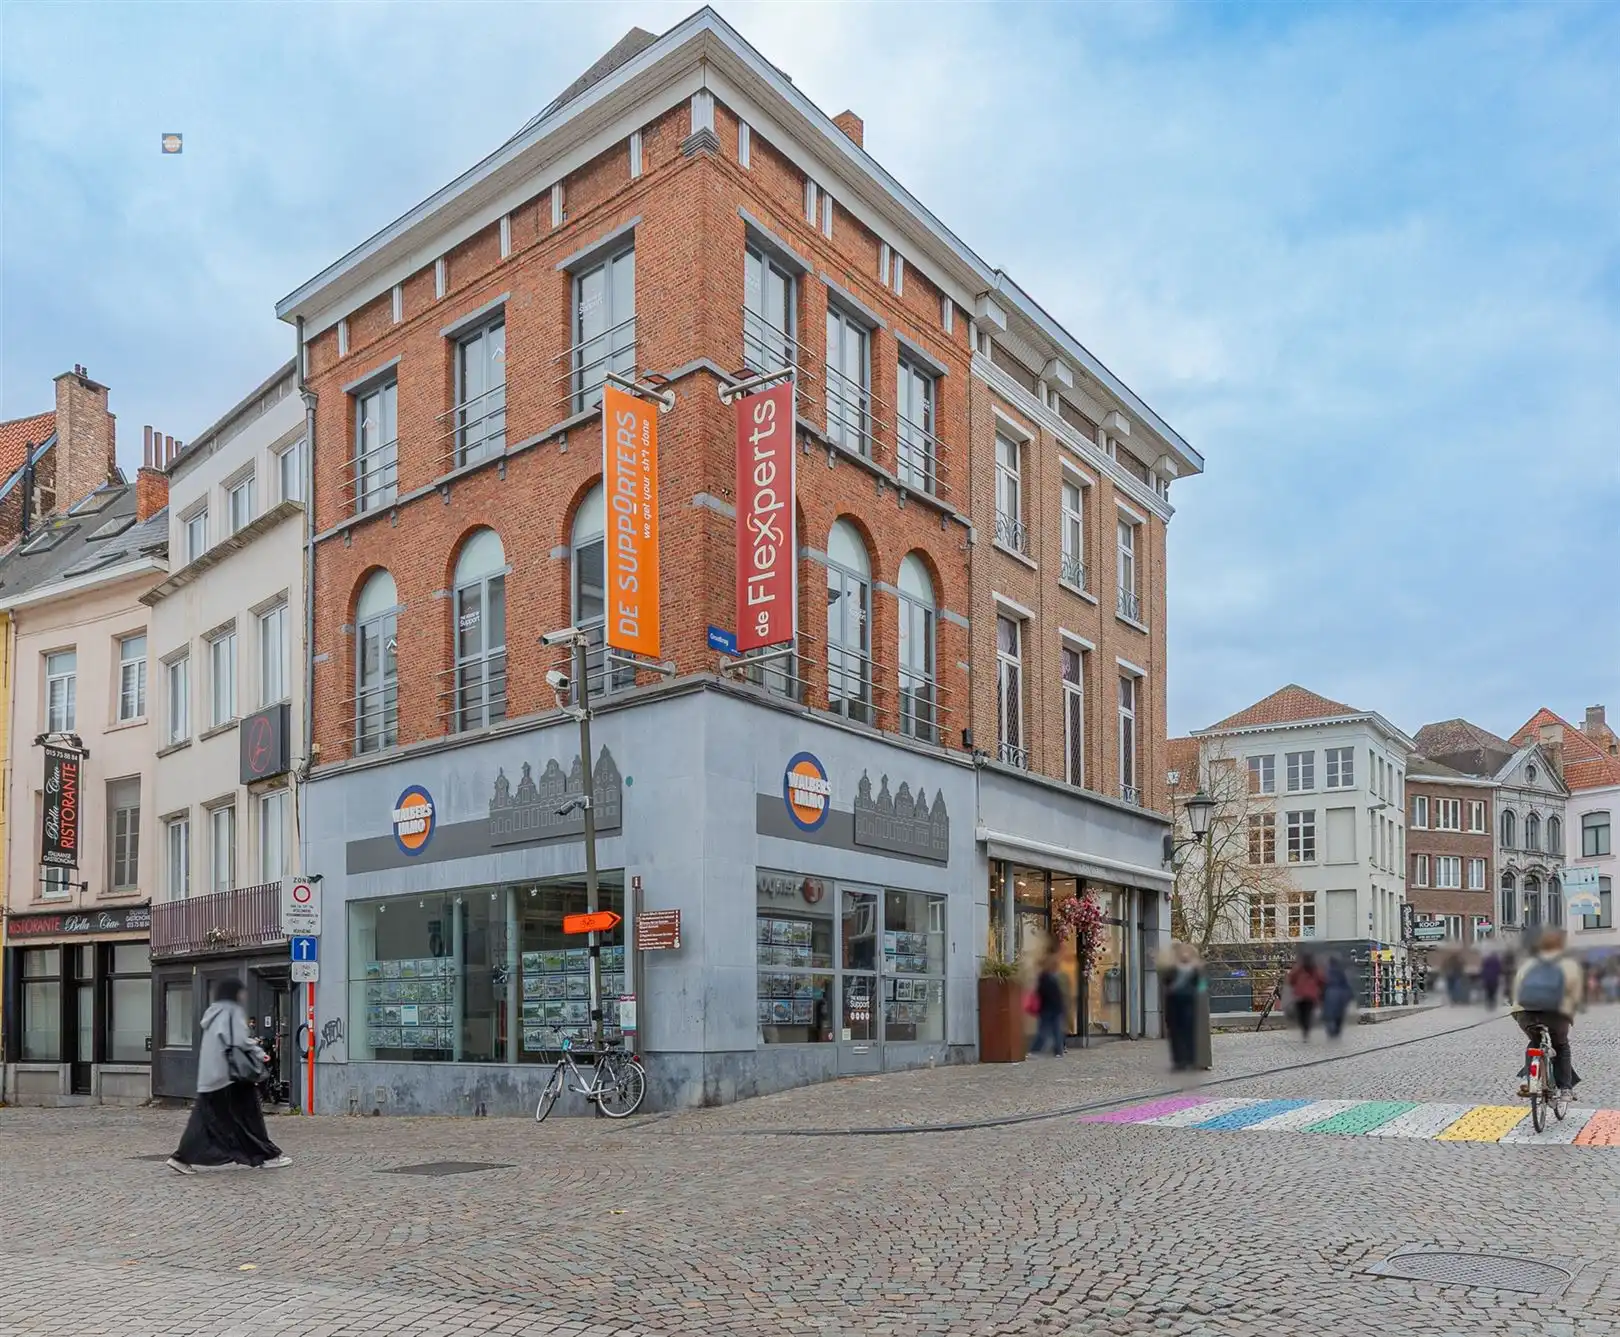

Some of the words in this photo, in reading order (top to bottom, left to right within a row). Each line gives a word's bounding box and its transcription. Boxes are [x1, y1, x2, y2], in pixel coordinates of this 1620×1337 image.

[641, 419, 650, 446] done
[612, 410, 639, 593] SUPPORTERS
[643, 476, 653, 500] your
[643, 504, 652, 521] get
[747, 399, 785, 606] Flexperts
[644, 523, 651, 539] we
[619, 600, 639, 637] DE
[755, 610, 769, 637] de
[46, 766, 61, 794] Ciao
[61, 762, 77, 849] RISTORANTE
[45, 804, 60, 841] Bella
[8, 916, 61, 935] RISTORANTE
[64, 914, 90, 933] Bella
[97, 911, 121, 930] Ciao
